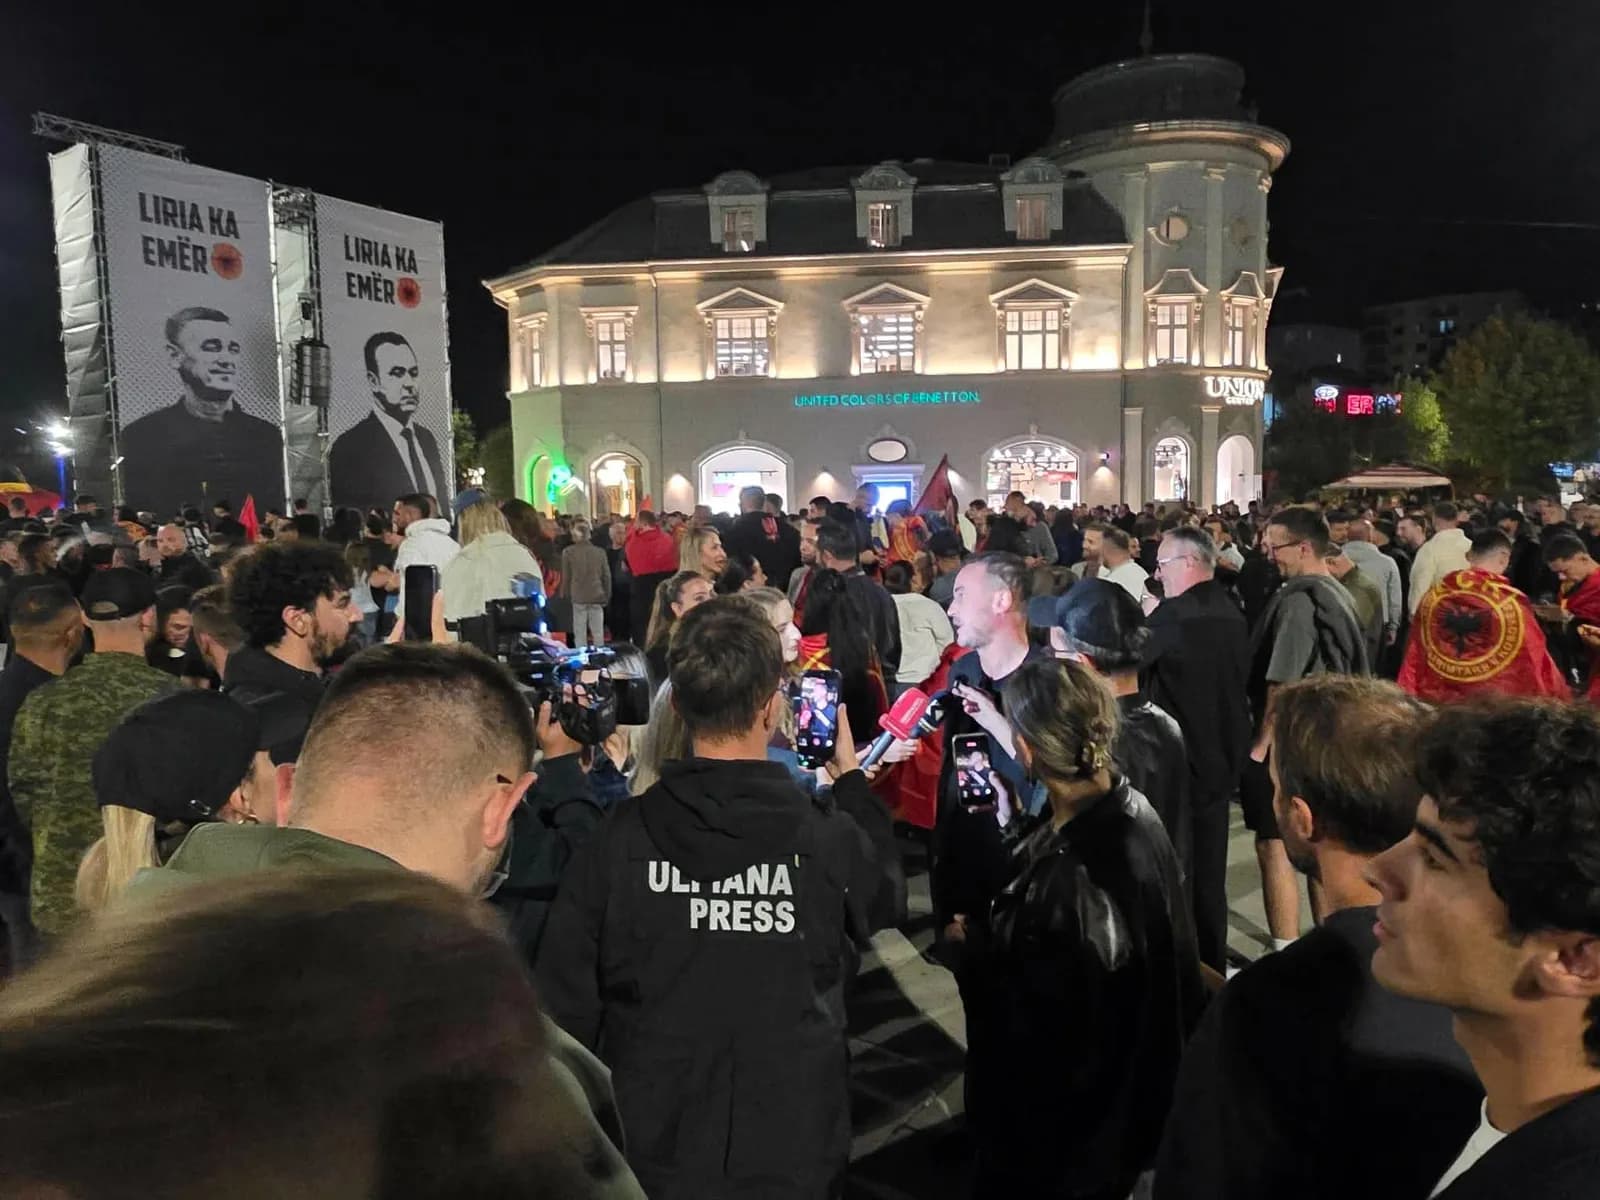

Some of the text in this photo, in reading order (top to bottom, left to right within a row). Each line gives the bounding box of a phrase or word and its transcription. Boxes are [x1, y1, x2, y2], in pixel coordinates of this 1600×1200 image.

[138, 191, 240, 239] LIRIA KA
[142, 234, 208, 275] EMËR
[344, 234, 418, 275] LIRIA KA
[346, 271, 395, 305] EMËR
[794, 394, 839, 407] UNITED
[840, 392, 891, 406] COLORS
[893, 392, 909, 405] OF
[1204, 376, 1265, 402] UNION
[648, 860, 793, 896] ULANA
[690, 897, 796, 934] PRESS
